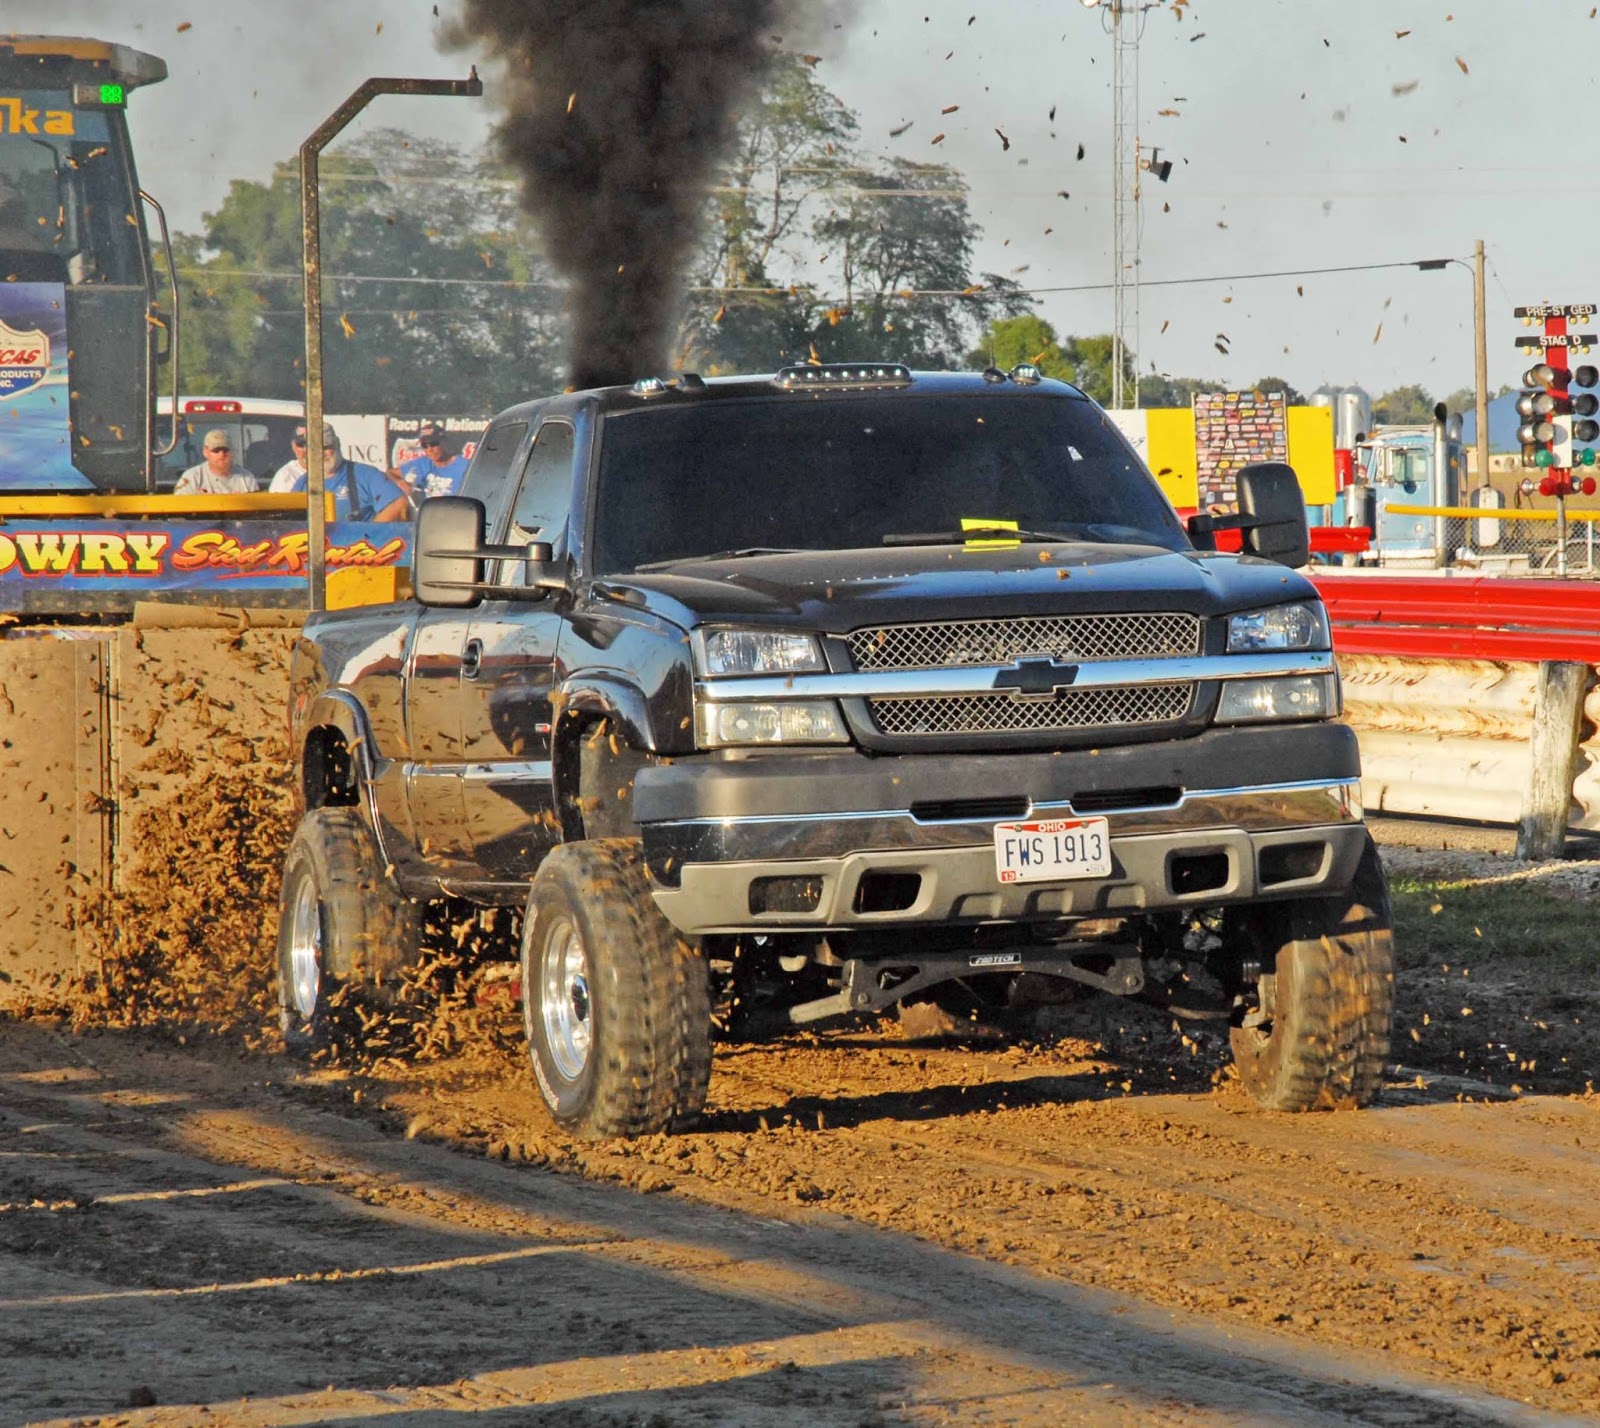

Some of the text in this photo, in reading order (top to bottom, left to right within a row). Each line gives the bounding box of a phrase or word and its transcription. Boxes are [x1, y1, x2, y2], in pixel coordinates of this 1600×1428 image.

[0, 97, 75, 135] ka
[1526, 305, 1593, 316] PRE-STGED
[1539, 335, 1581, 346] STAGD
[0, 349, 41, 365] CAS
[0, 370, 41, 379] ODUCTS
[389, 417, 419, 431] Race
[445, 417, 493, 432] Nationa
[269, 532, 404, 571] Rntal
[1038, 823, 1066, 832] OHIO
[1006, 834, 1102, 867] FWS 1913
